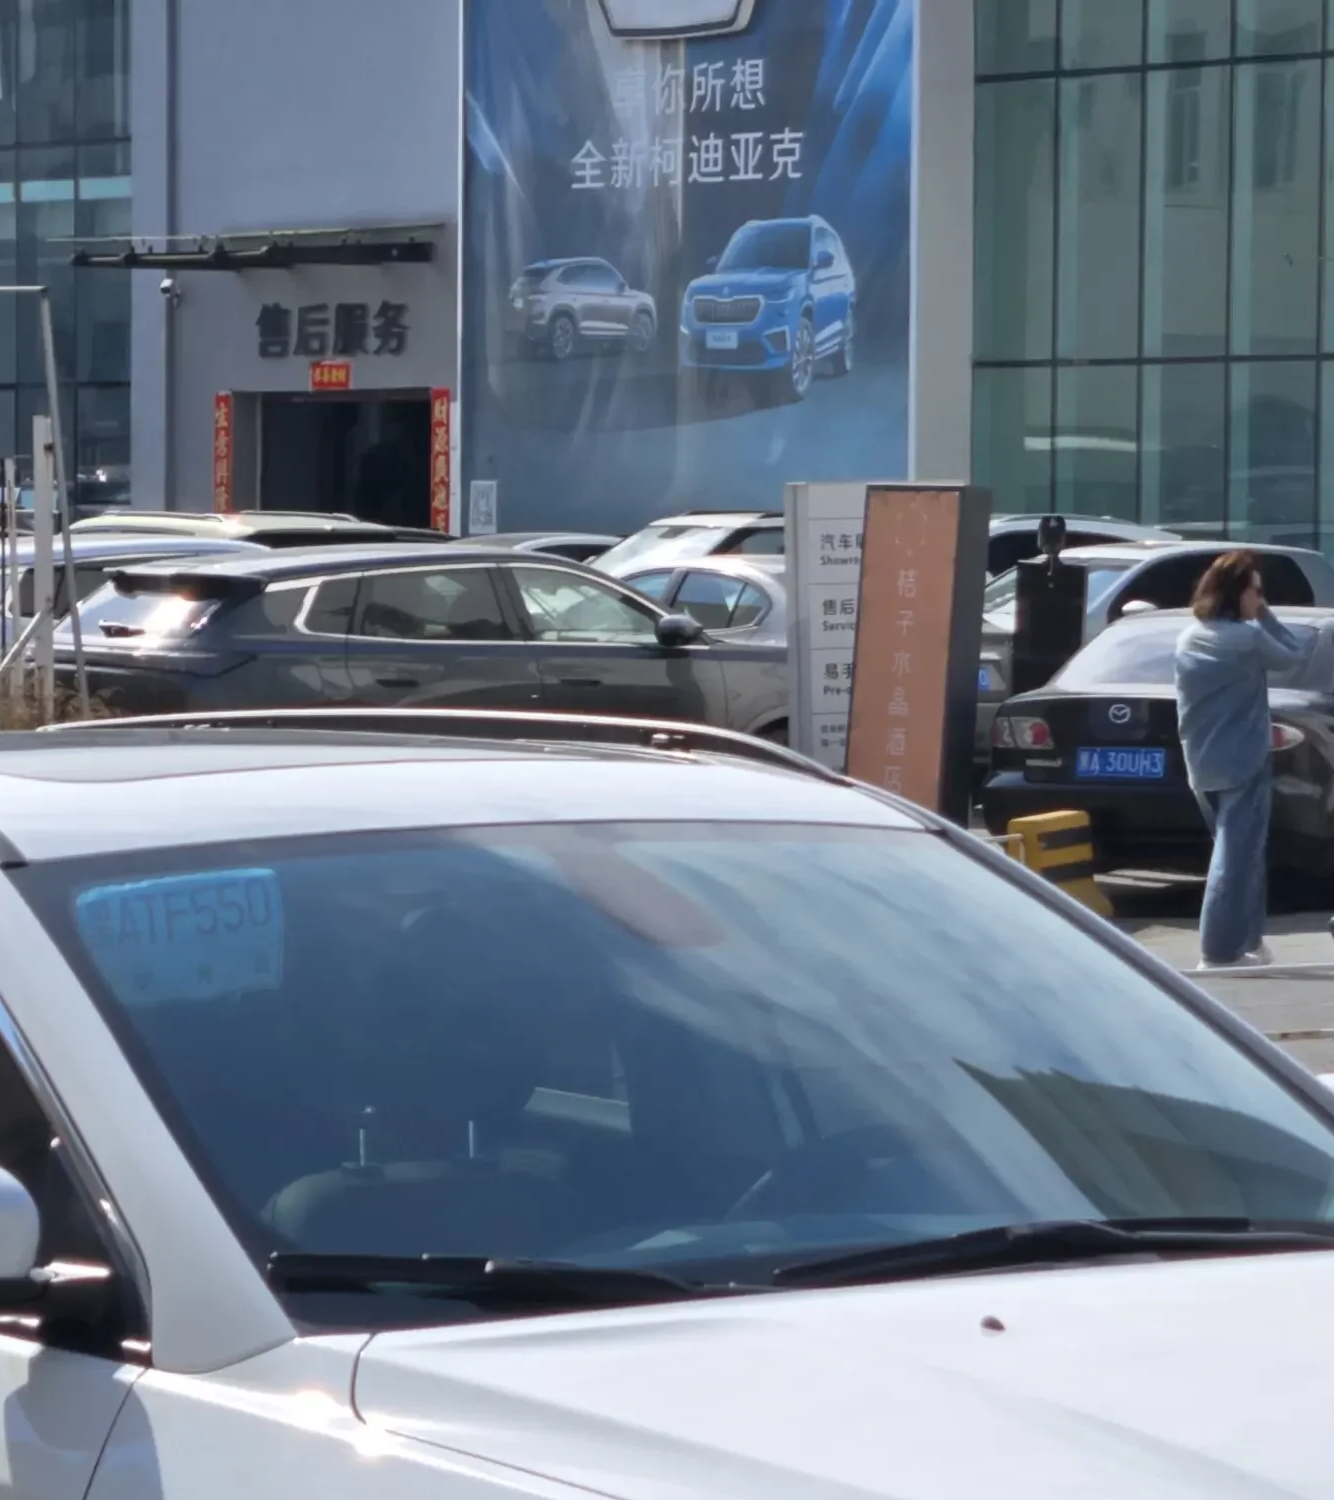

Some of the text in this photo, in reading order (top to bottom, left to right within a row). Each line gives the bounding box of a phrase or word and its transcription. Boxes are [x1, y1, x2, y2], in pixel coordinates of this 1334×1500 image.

[570, 127, 804, 189] 全新柯迪亚克
[255, 301, 411, 358] 售后服务
